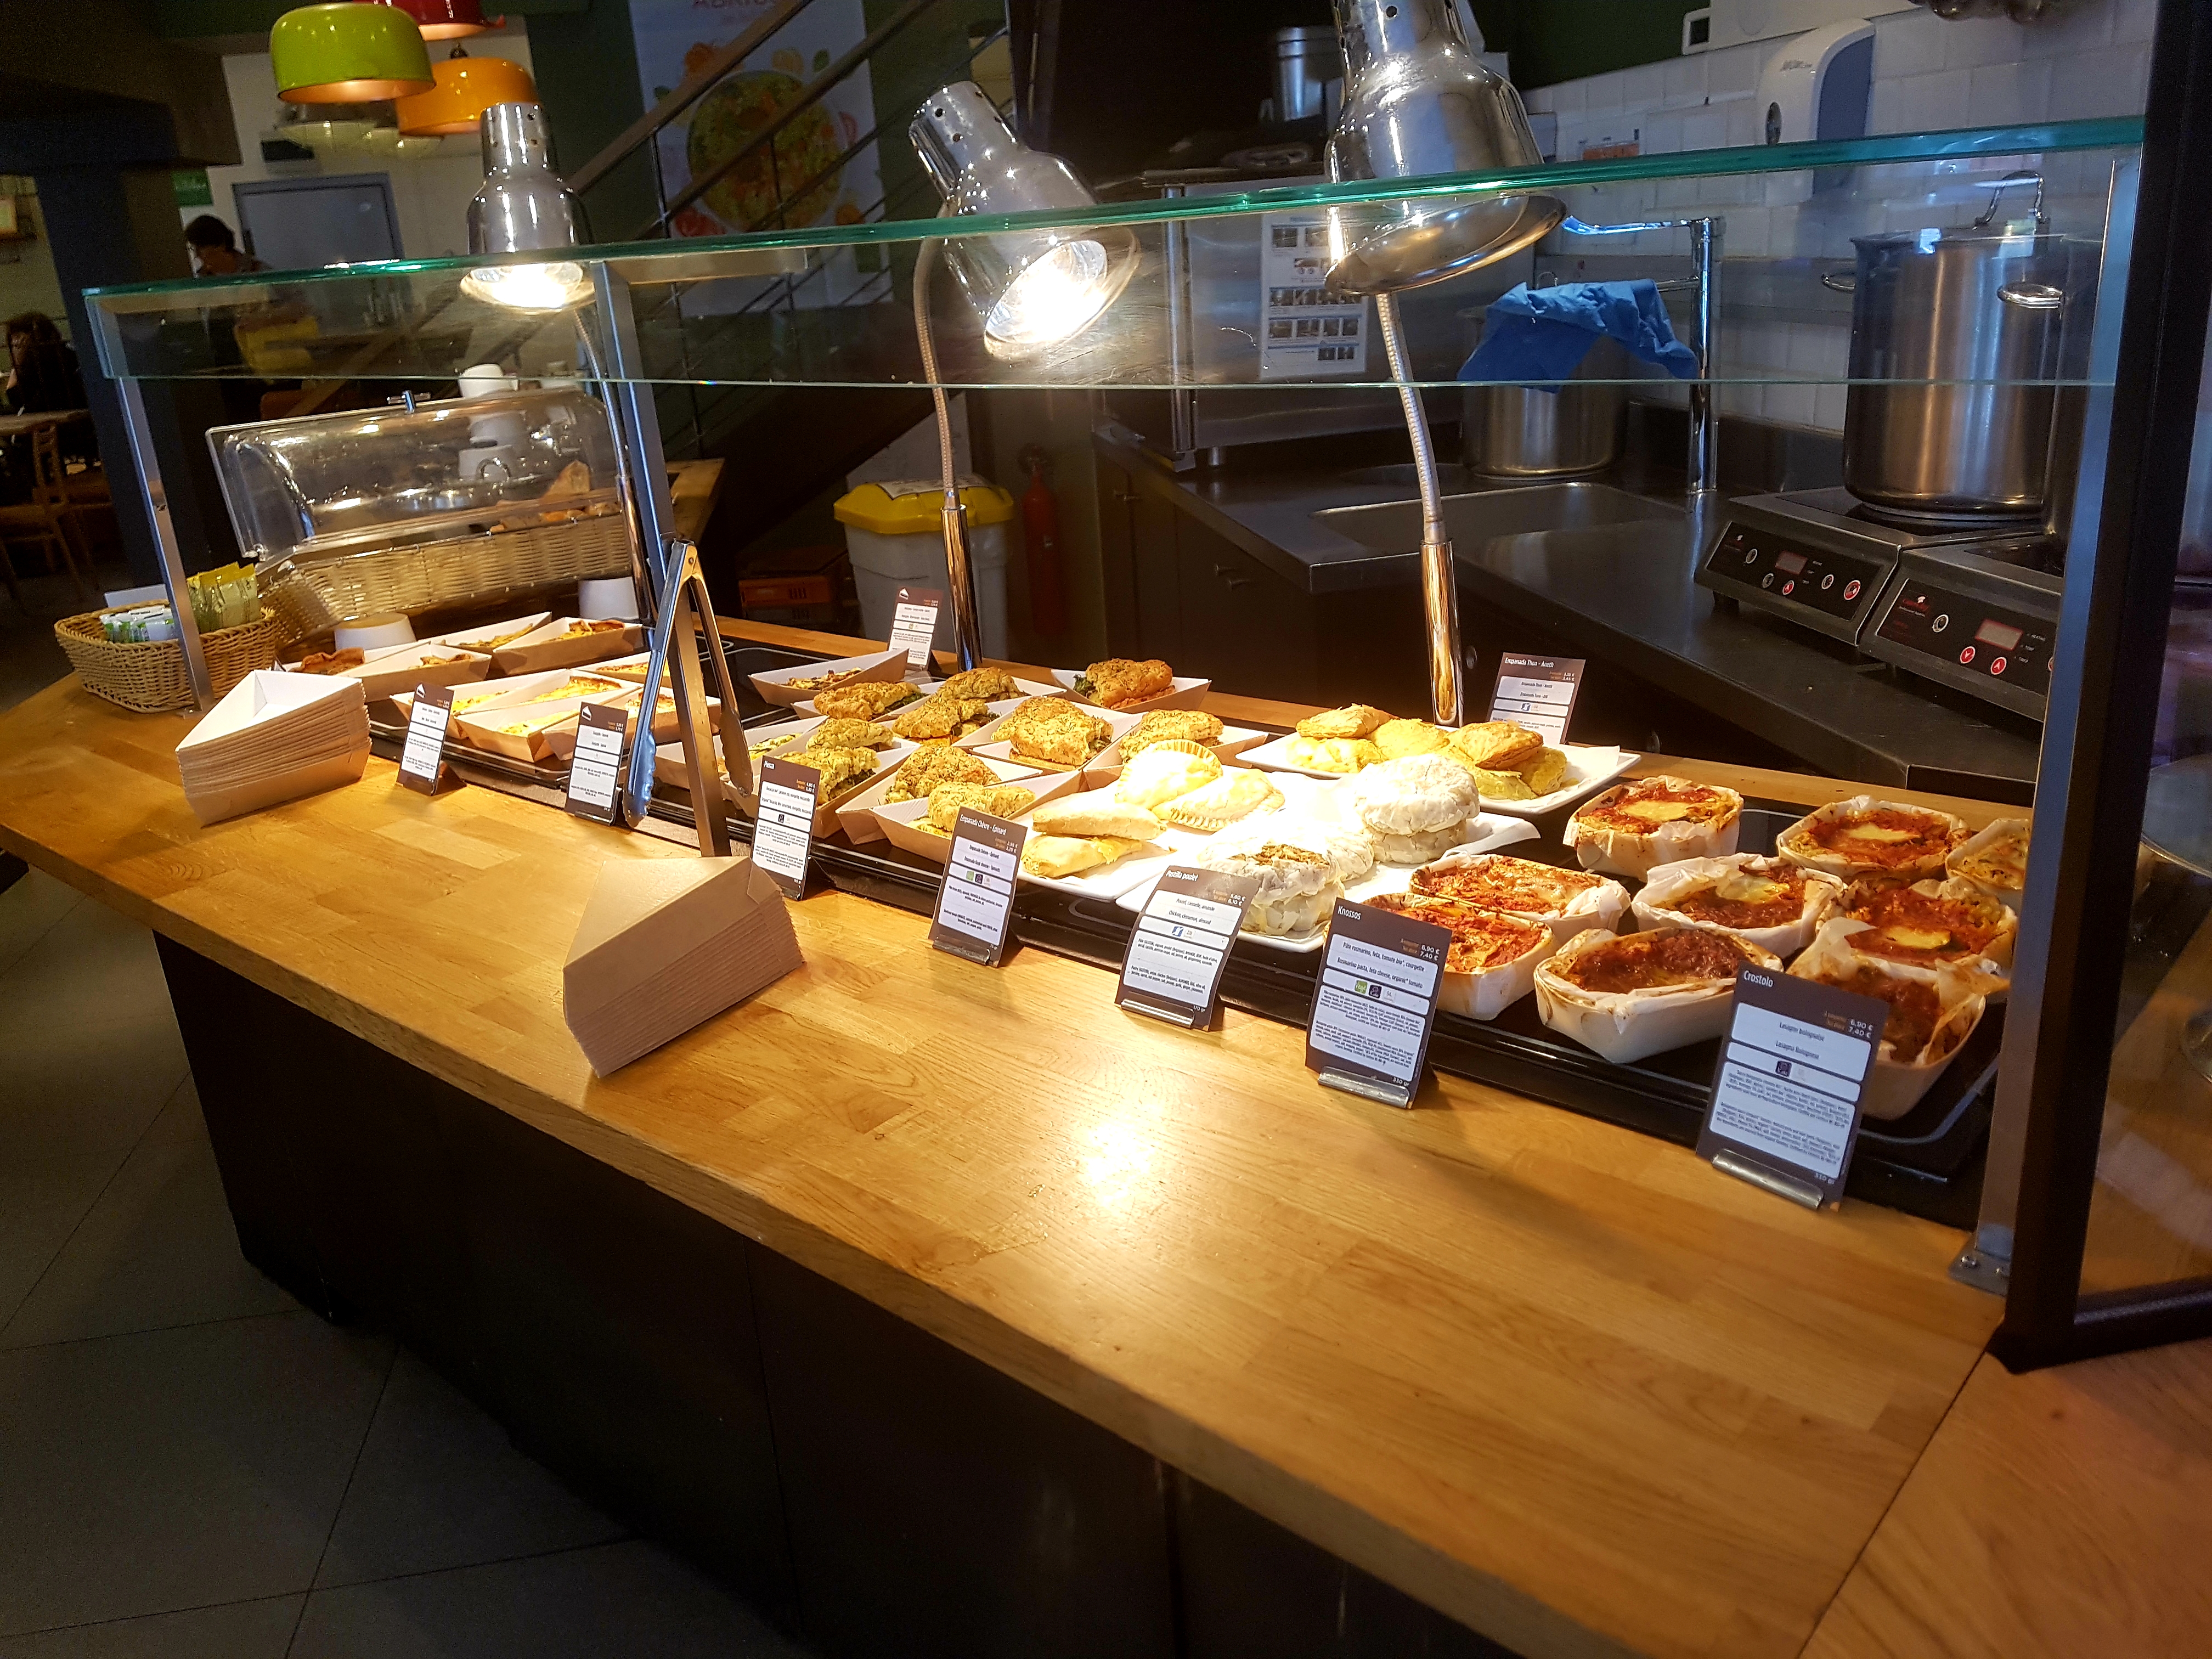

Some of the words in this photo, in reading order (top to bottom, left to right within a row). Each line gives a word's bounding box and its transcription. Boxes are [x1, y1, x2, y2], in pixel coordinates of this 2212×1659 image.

[1505, 657, 1527, 665] Empanada
[1338, 905, 1362, 921] Knossos
[1743, 970, 1774, 988] Crostolo
